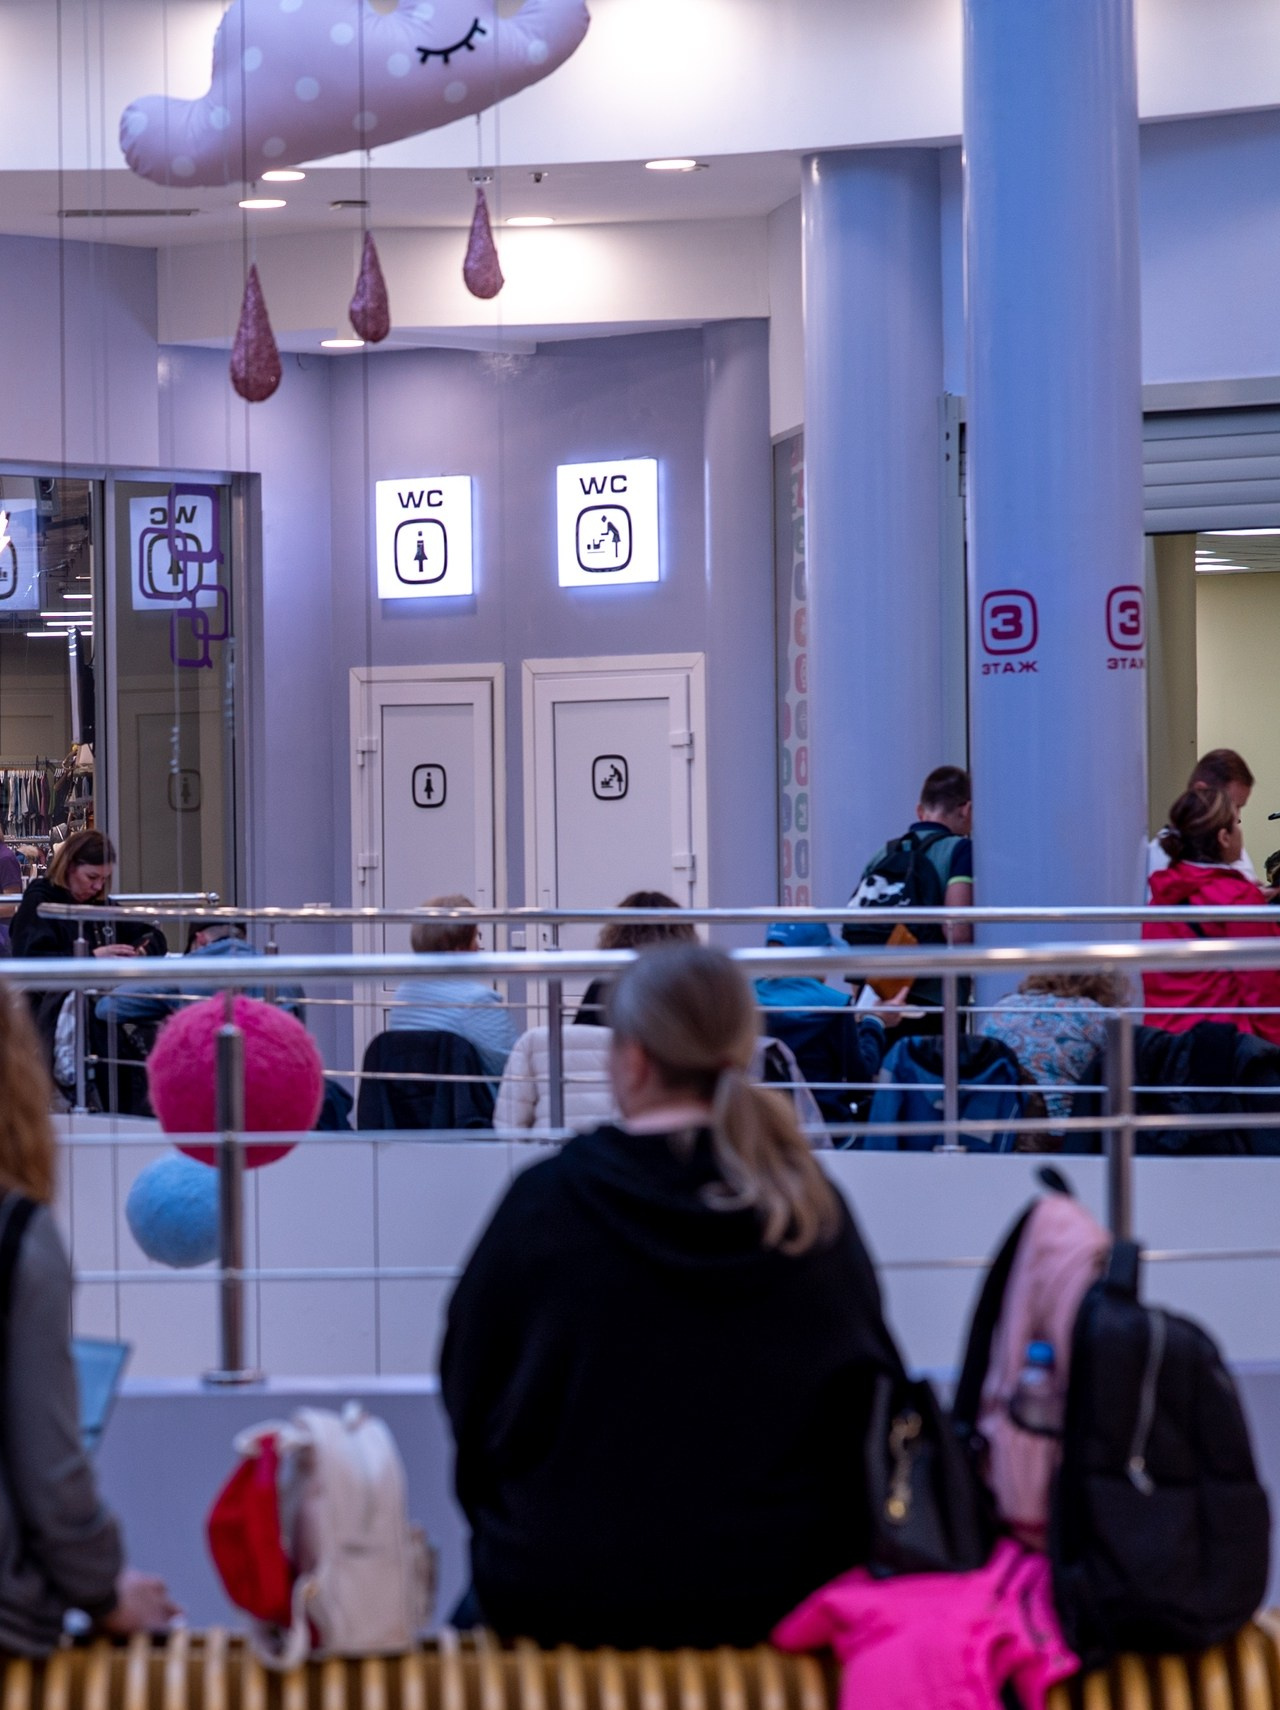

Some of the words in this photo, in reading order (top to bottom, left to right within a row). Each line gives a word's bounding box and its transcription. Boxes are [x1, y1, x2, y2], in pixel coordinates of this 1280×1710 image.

[580, 474, 628, 495] WC
[398, 489, 443, 509] WC
[991, 604, 1023, 640] 3
[1118, 600, 1140, 636] 3
[981, 660, 1038, 676] ЭТАЖ
